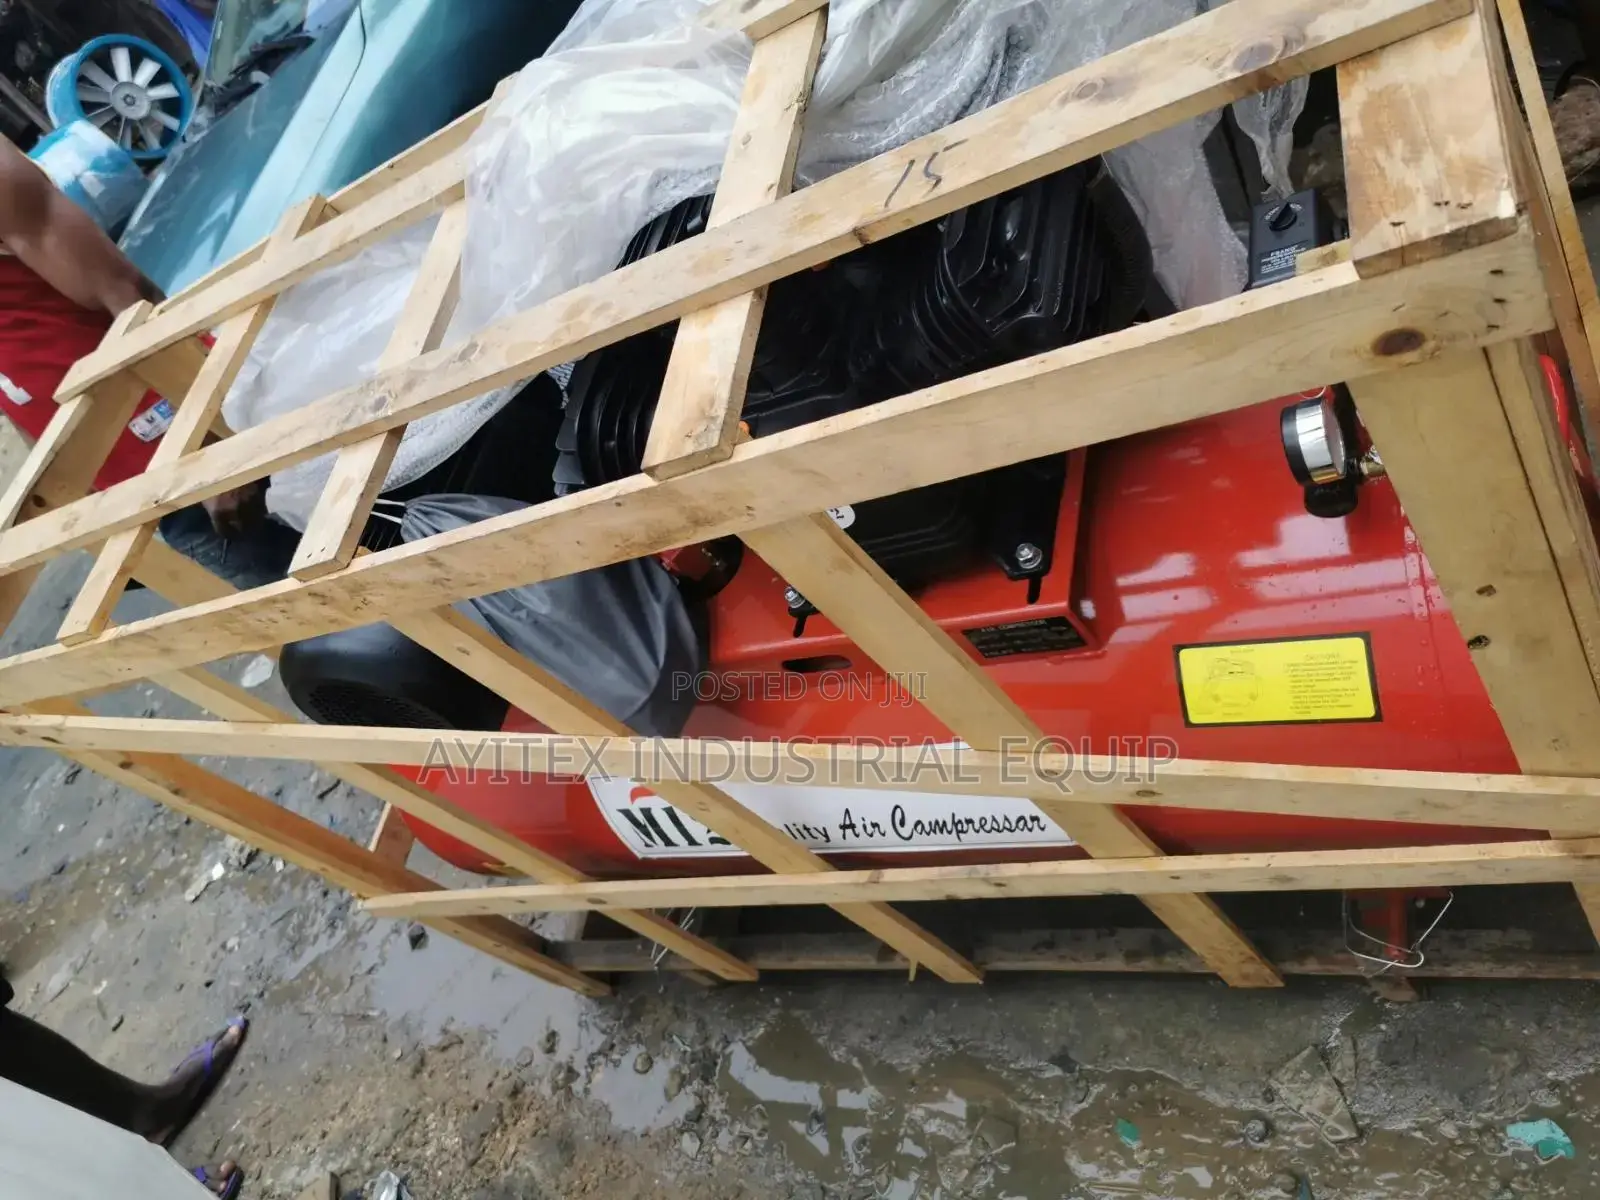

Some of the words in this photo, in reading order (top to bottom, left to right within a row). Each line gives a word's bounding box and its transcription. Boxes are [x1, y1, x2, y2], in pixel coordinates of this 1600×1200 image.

[884, 139, 969, 209] 15
[616, 806, 733, 848] MI
[838, 807, 886, 840] Air
